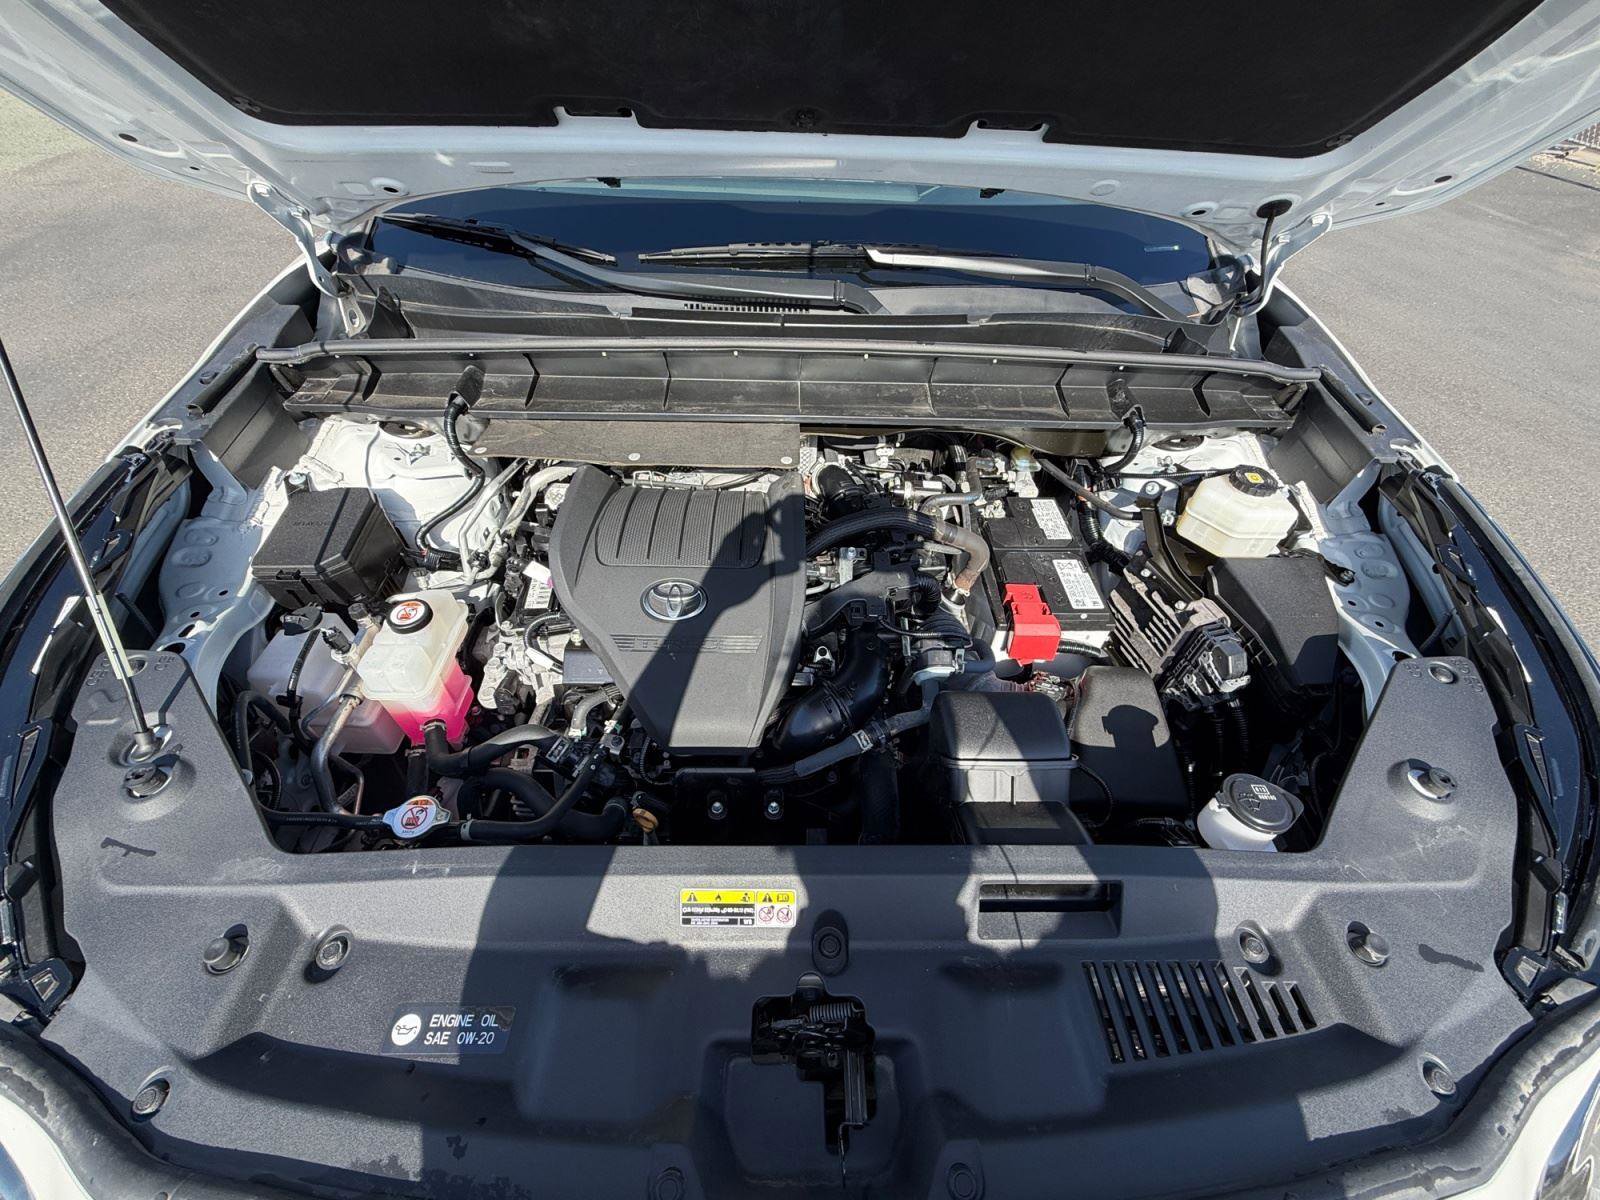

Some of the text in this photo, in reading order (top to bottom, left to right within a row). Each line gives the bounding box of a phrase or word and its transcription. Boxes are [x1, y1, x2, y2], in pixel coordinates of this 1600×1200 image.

[636, 638, 719, 650] TUO
[429, 1014, 499, 1027] ENGINE OIL
[424, 1031, 495, 1045] SAE 0W-20
